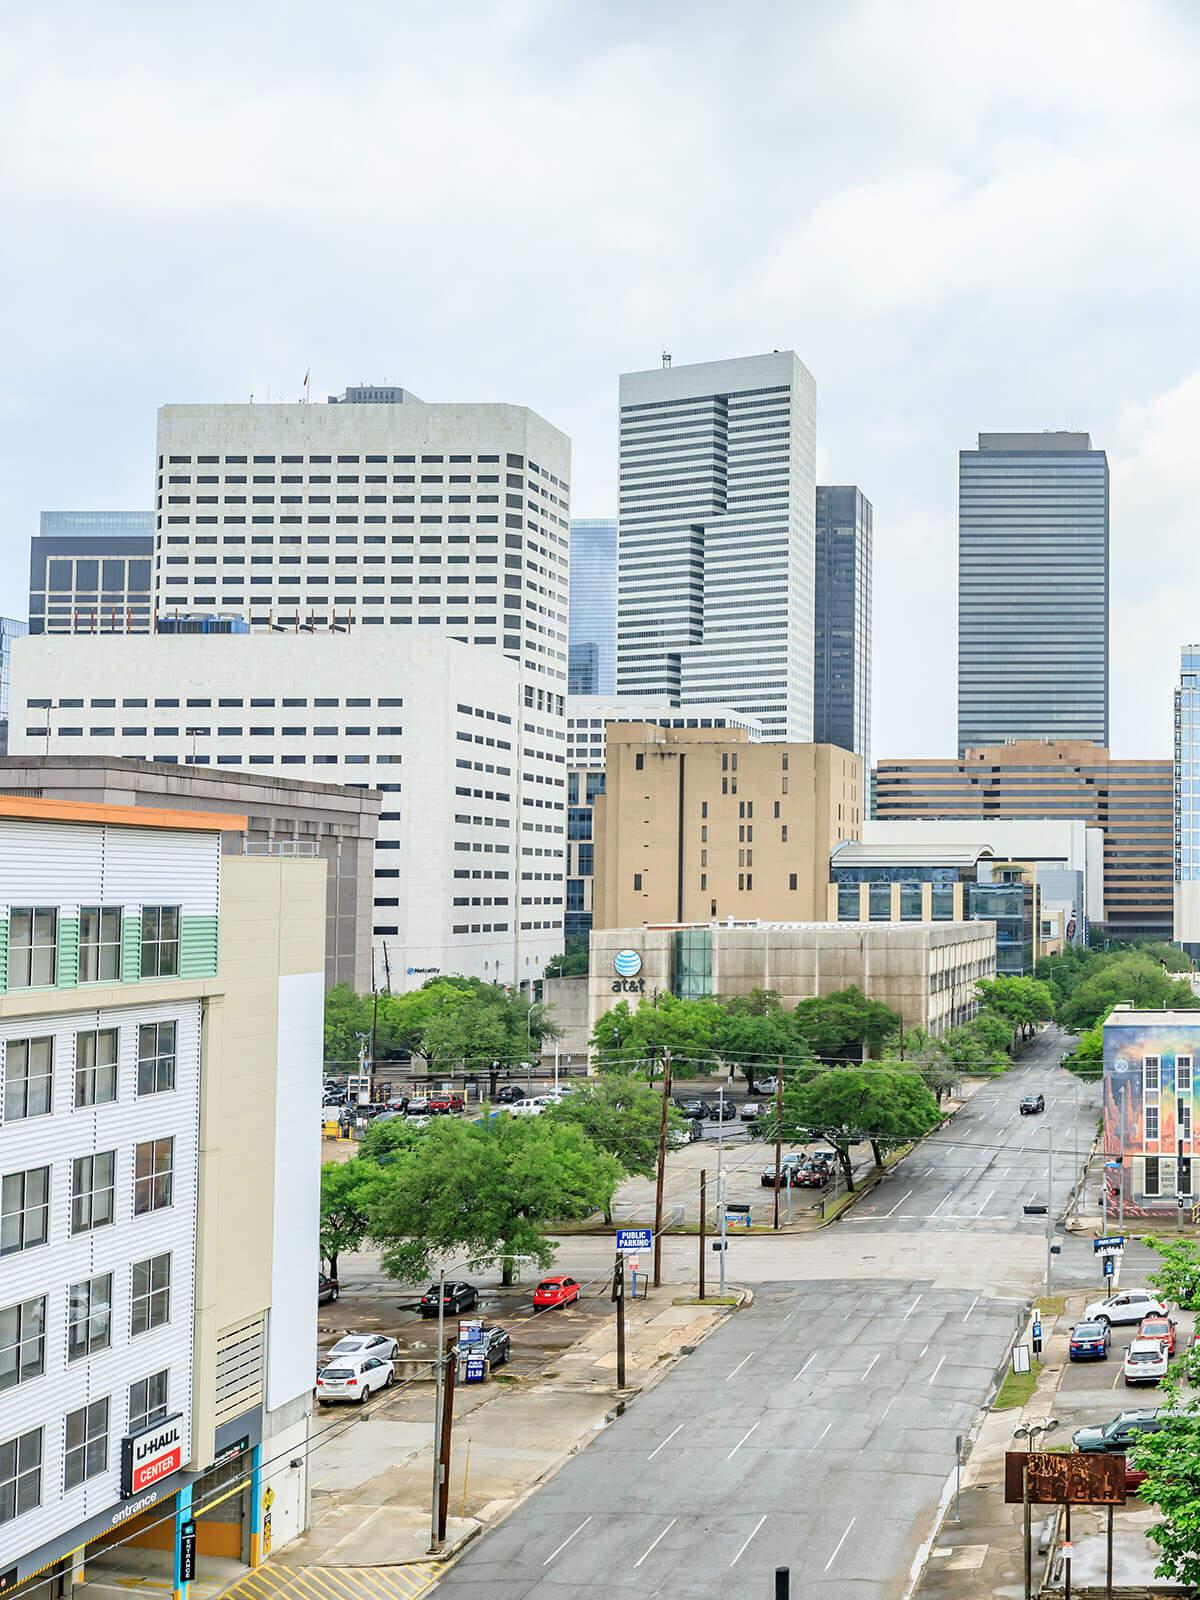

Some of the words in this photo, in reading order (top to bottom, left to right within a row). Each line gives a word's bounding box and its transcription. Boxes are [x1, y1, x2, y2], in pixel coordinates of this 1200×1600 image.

[611, 978, 645, 993] at&t
[619, 1239, 649, 1247] PARKING
[622, 1231, 646, 1239] PUBLIC
[137, 1428, 180, 1460] U-HAUL
[140, 1456, 174, 1483] CENTER
[112, 1492, 157, 1524] entrance
